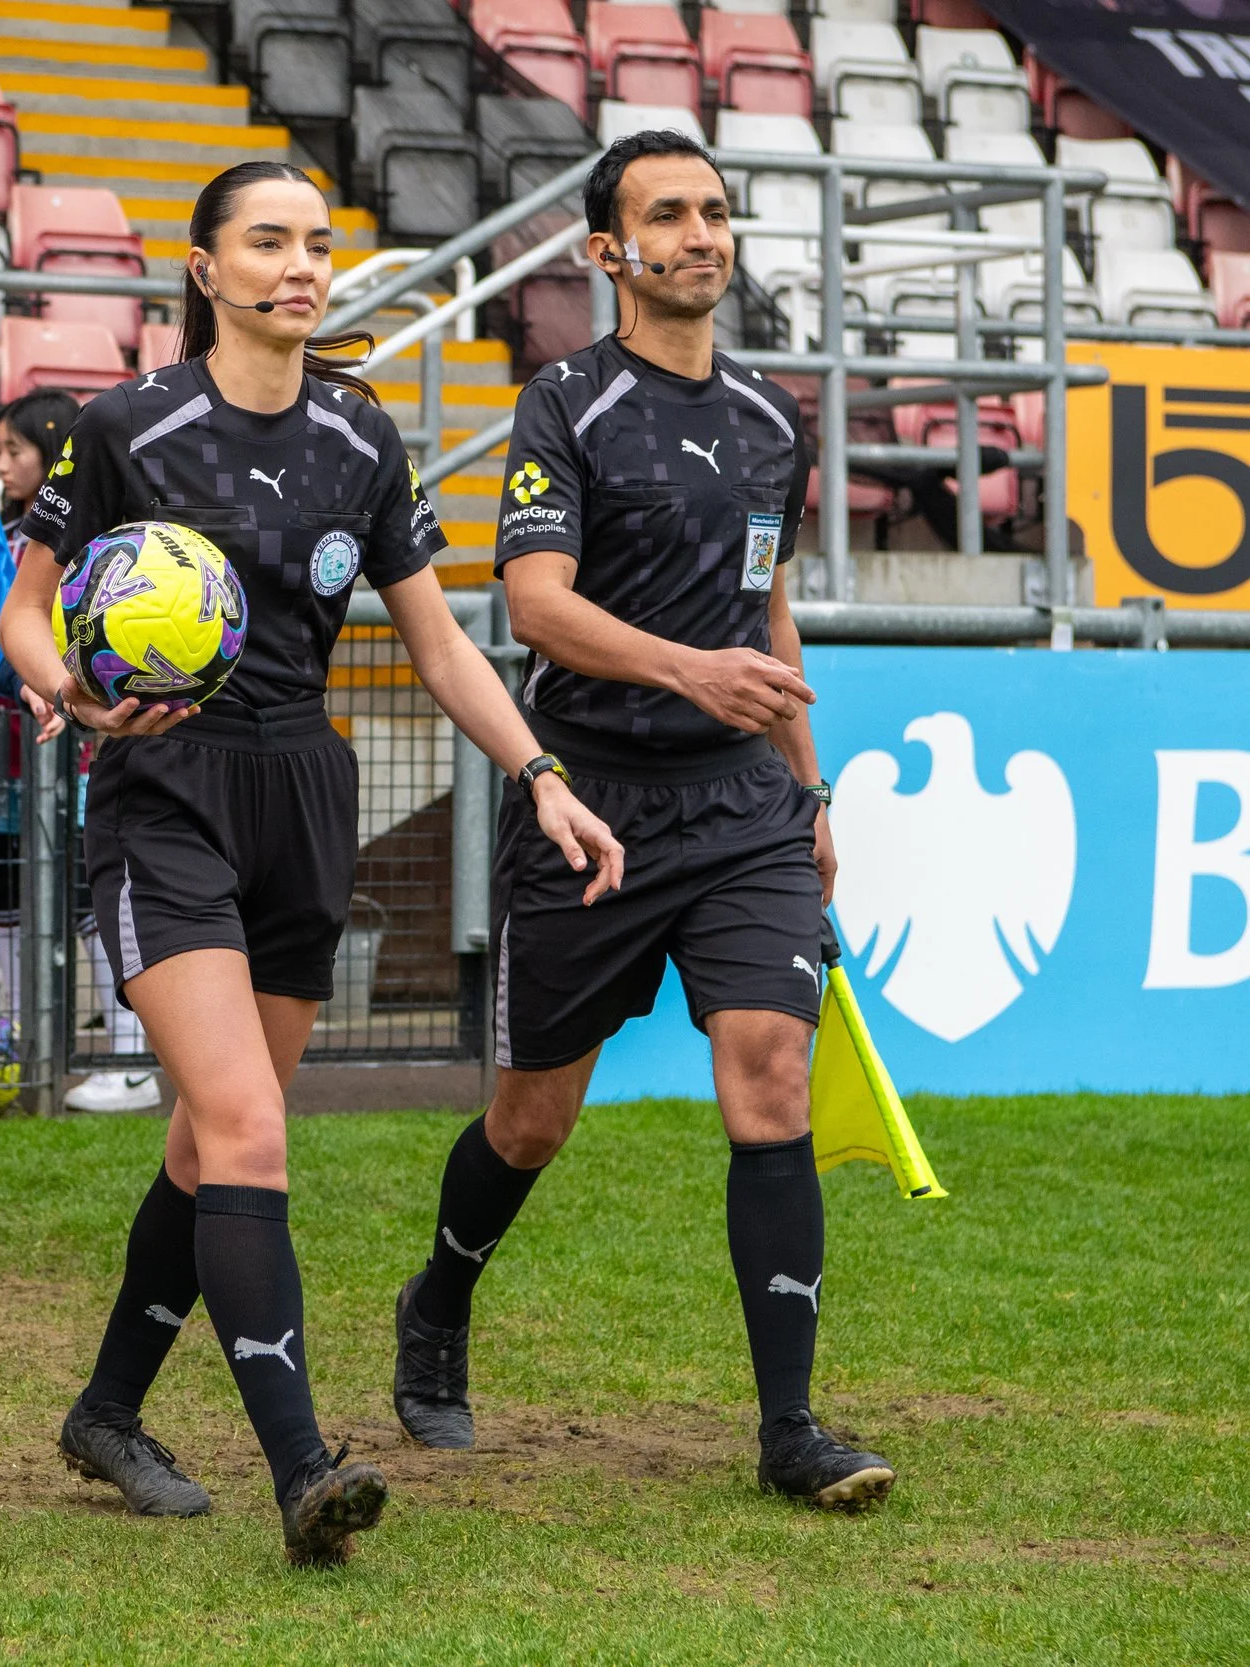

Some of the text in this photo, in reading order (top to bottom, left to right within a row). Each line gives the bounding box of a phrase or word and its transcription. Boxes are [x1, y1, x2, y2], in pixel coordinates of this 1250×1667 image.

[33, 502, 67, 529] Supplies
[503, 506, 566, 530] HuwsGray
[317, 534, 332, 553] BERKS
[339, 534, 355, 548] BUCKS
[503, 524, 566, 544] Building Supplies
[313, 563, 356, 594] FOOTBALL ASSOCIATION
